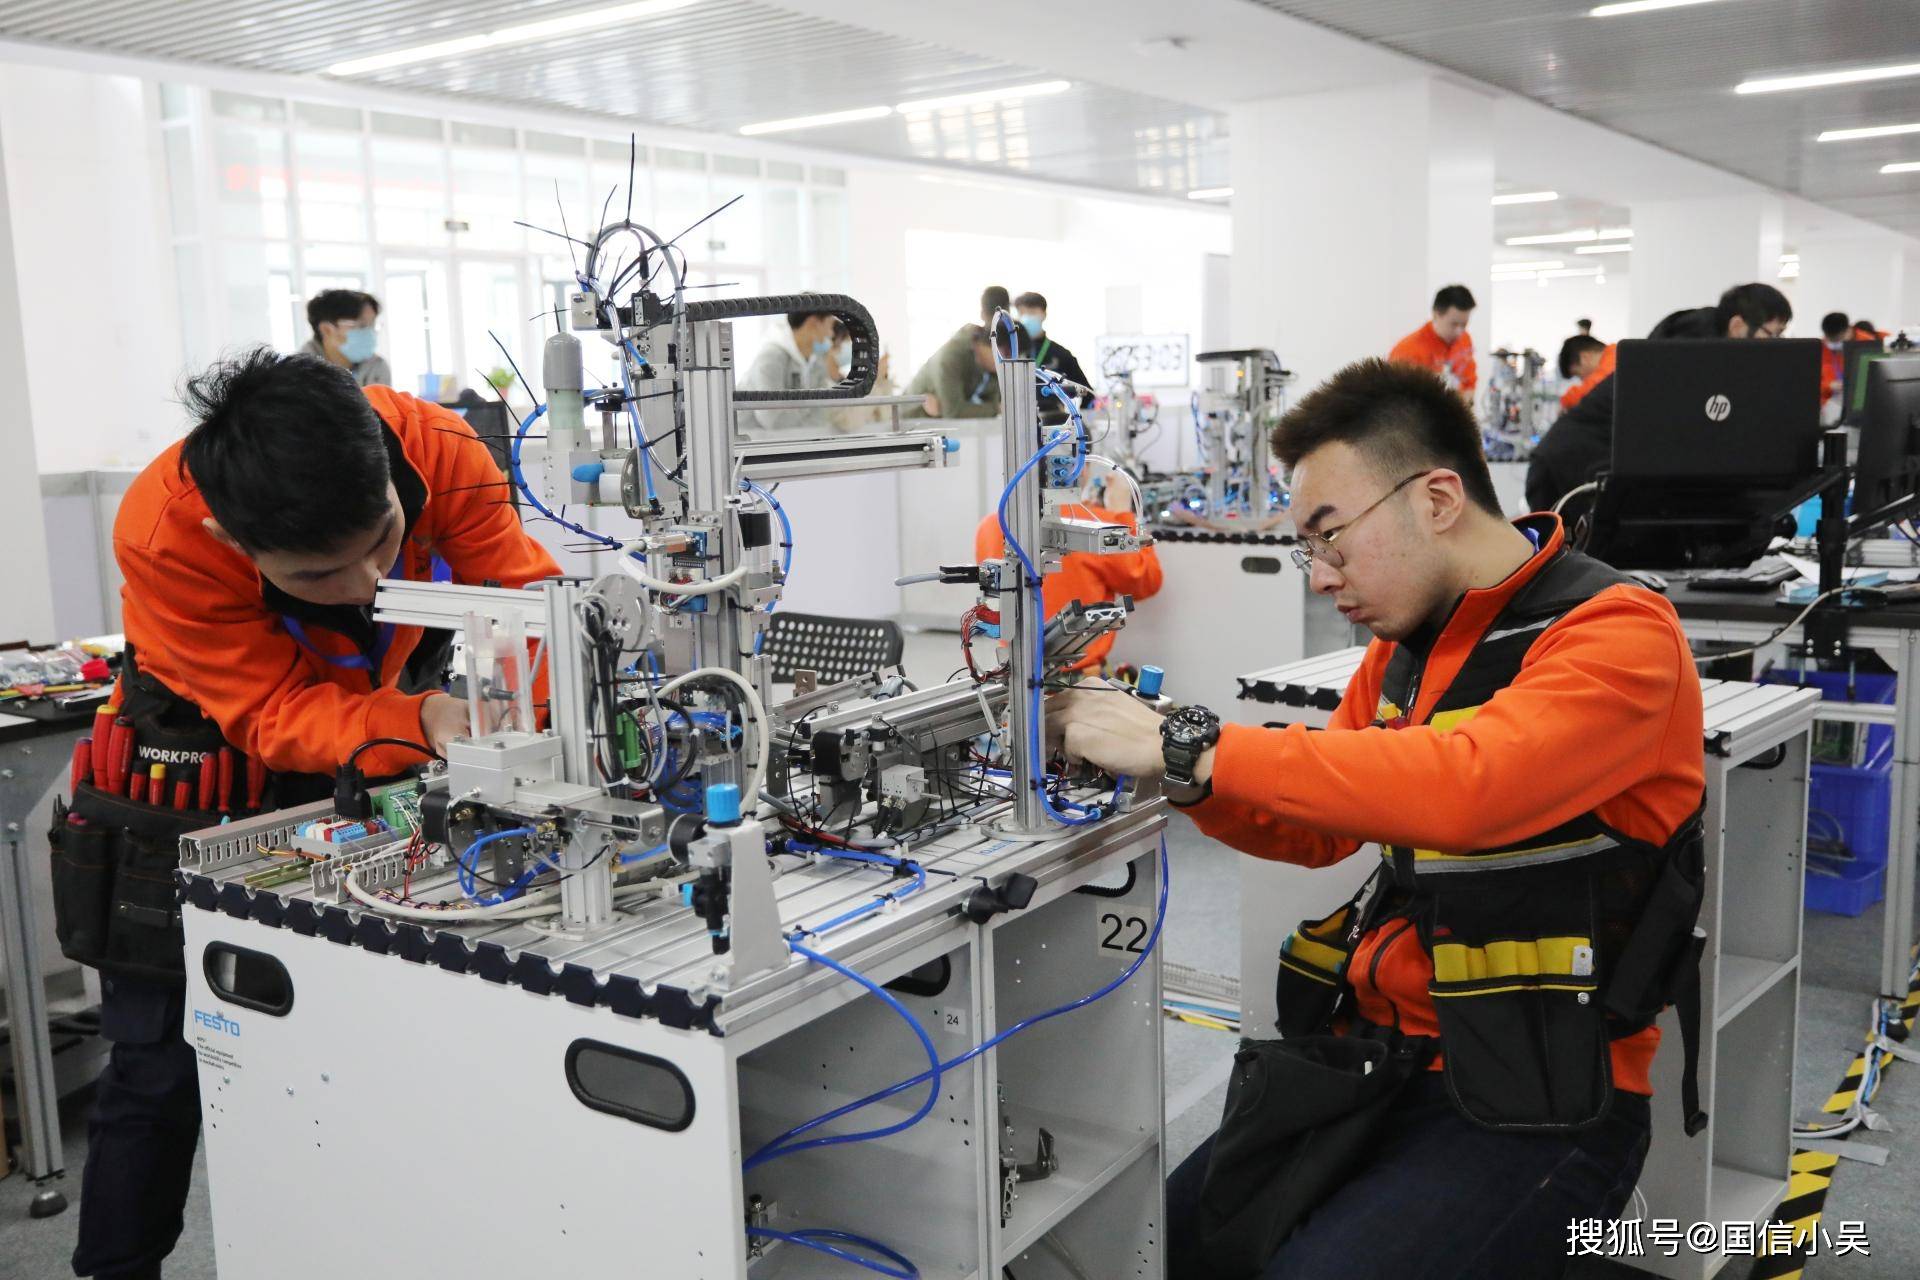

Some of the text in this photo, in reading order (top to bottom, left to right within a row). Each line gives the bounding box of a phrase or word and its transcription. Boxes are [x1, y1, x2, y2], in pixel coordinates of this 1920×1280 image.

[1706, 394, 1731, 421] hp
[1101, 913, 1149, 954] 22
[194, 1009, 240, 1037] FESTO
[947, 1014, 959, 1026] 24
